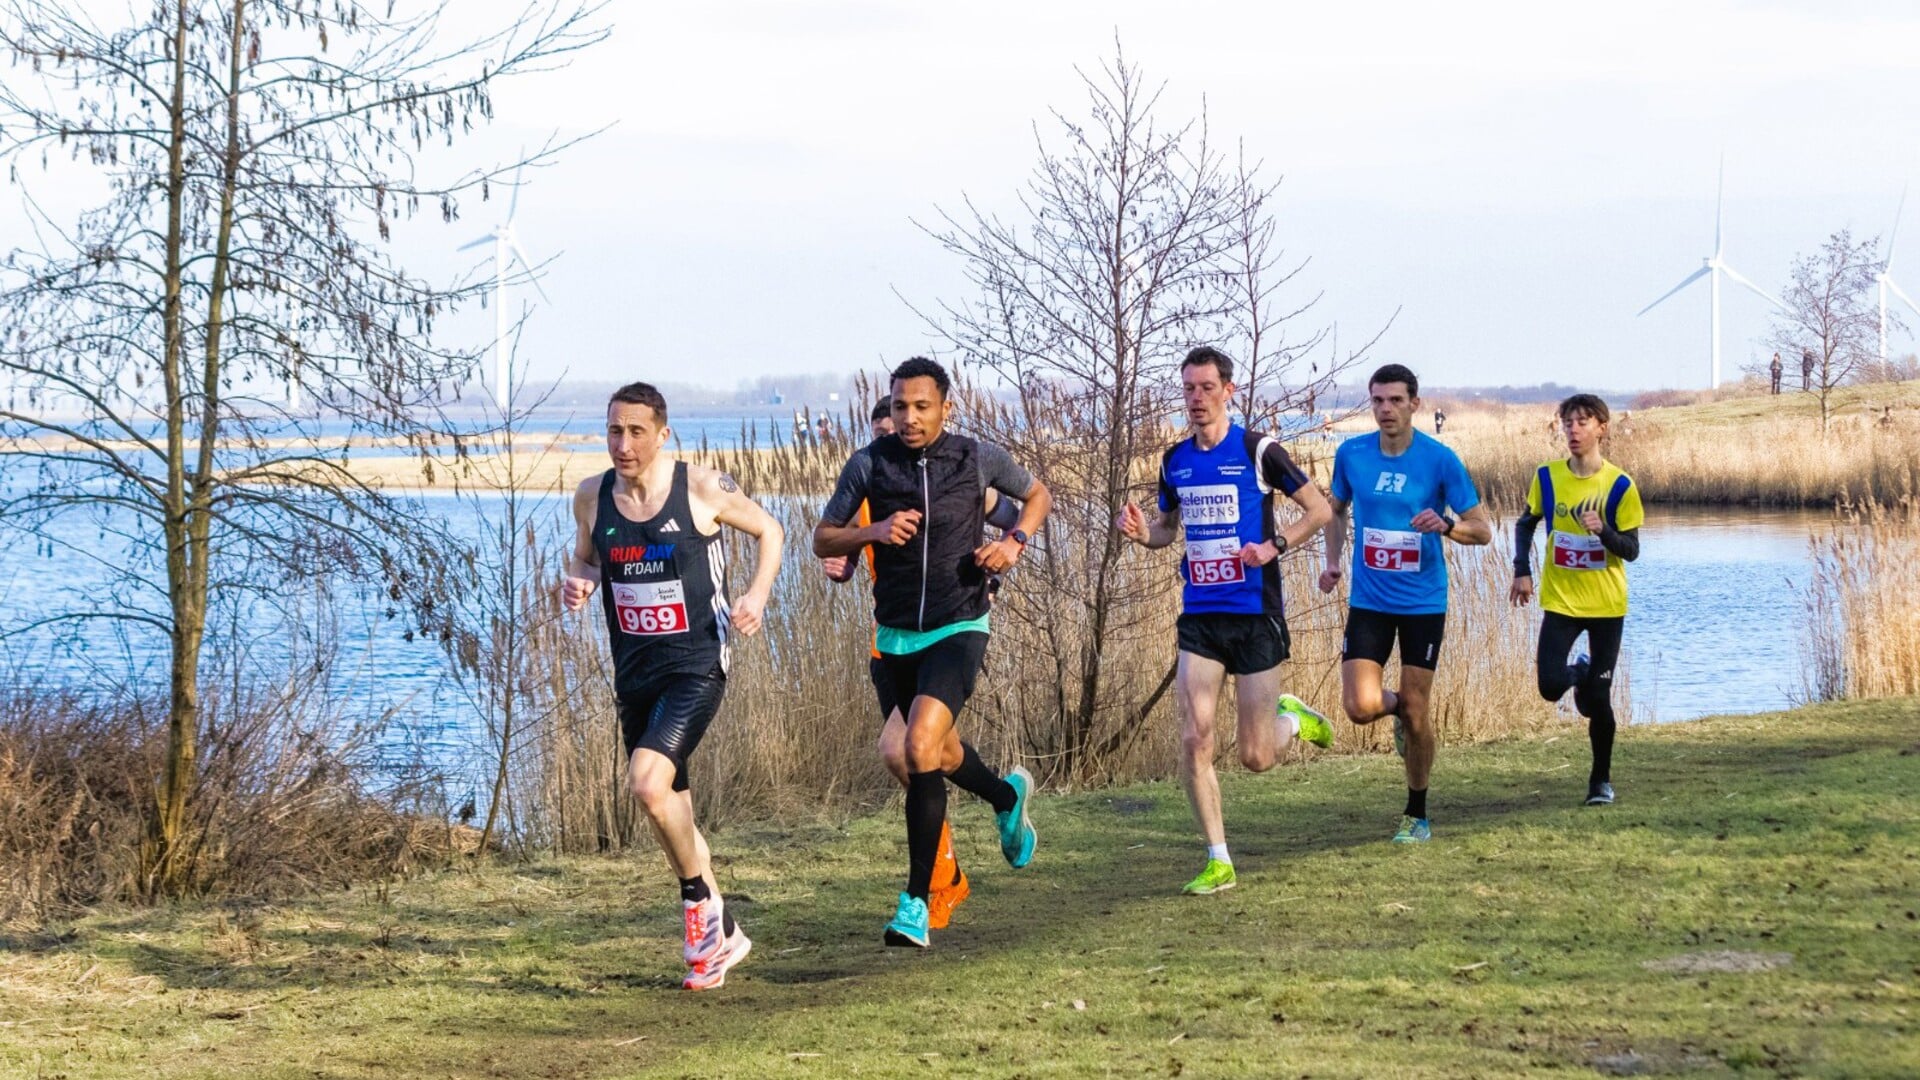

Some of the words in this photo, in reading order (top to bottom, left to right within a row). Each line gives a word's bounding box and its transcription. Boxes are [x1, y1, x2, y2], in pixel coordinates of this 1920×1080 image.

[1183, 506, 1235, 518] EUKENS
[1375, 549, 1402, 569] 91
[1565, 550, 1592, 567] 34
[624, 561, 664, 575] R'DAM
[1194, 560, 1236, 582] 956
[623, 606, 677, 632] 969
